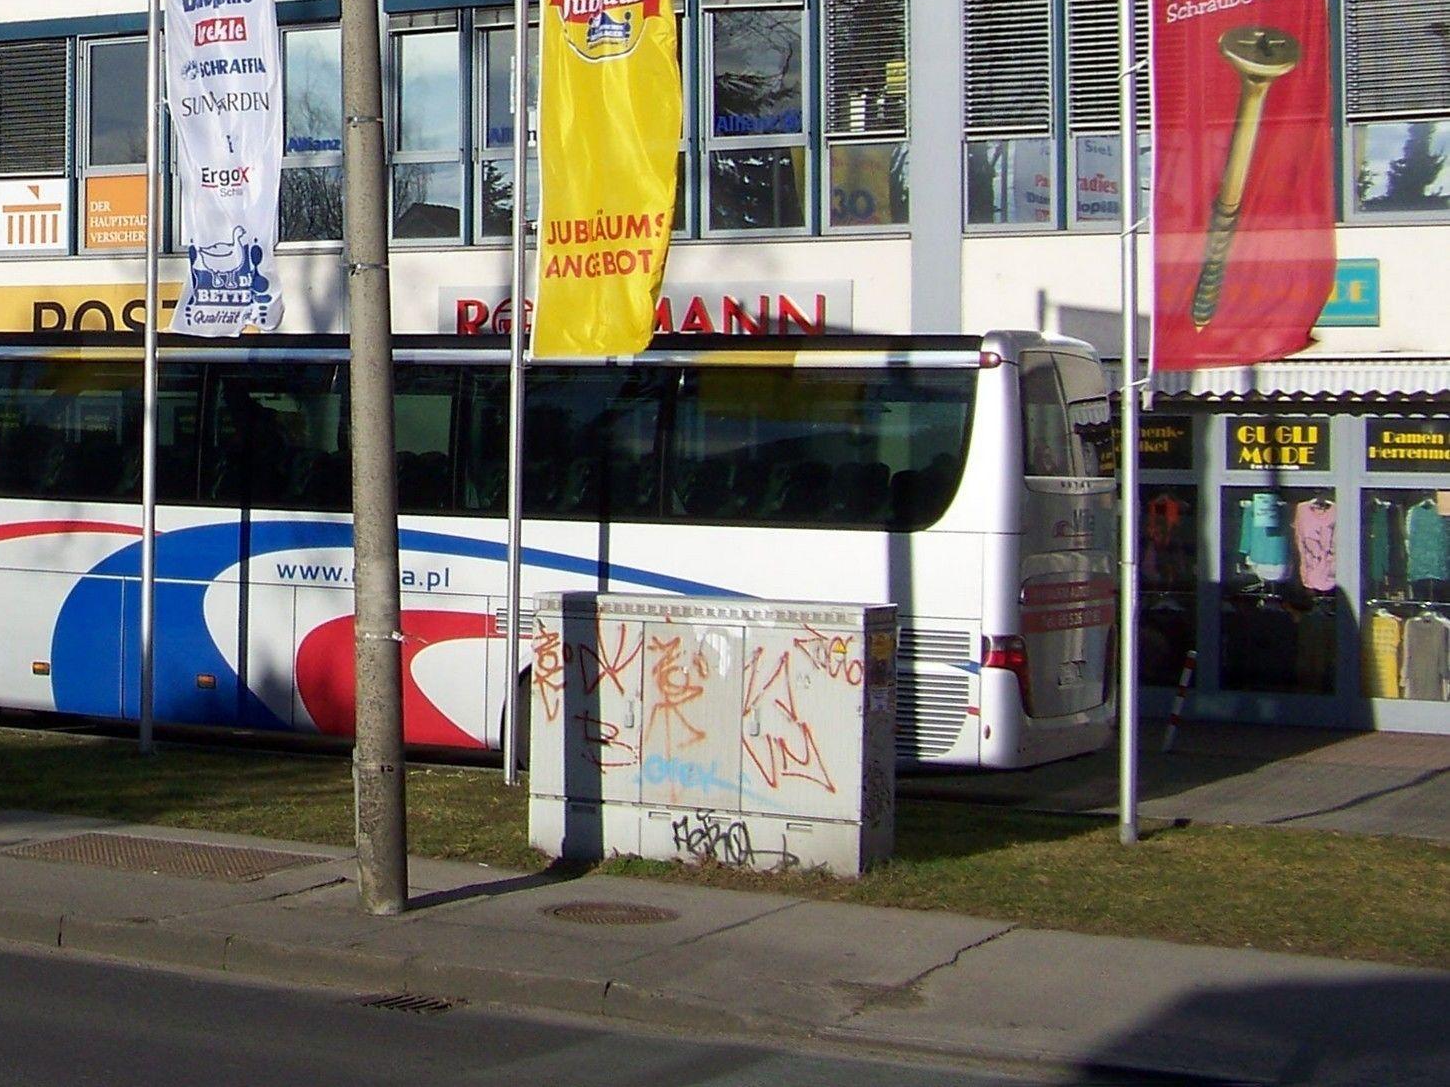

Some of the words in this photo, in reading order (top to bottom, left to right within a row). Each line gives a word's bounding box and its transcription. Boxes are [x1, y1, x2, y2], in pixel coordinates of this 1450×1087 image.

[287, 136, 341, 152] Allianz
[90, 200, 111, 212] DER
[194, 309, 241, 325] Qualität
[1237, 425, 1318, 444] GUGLI
[1383, 431, 1444, 444] Damen
[1238, 445, 1315, 465] MODE
[277, 563, 450, 592] www.a.pl
